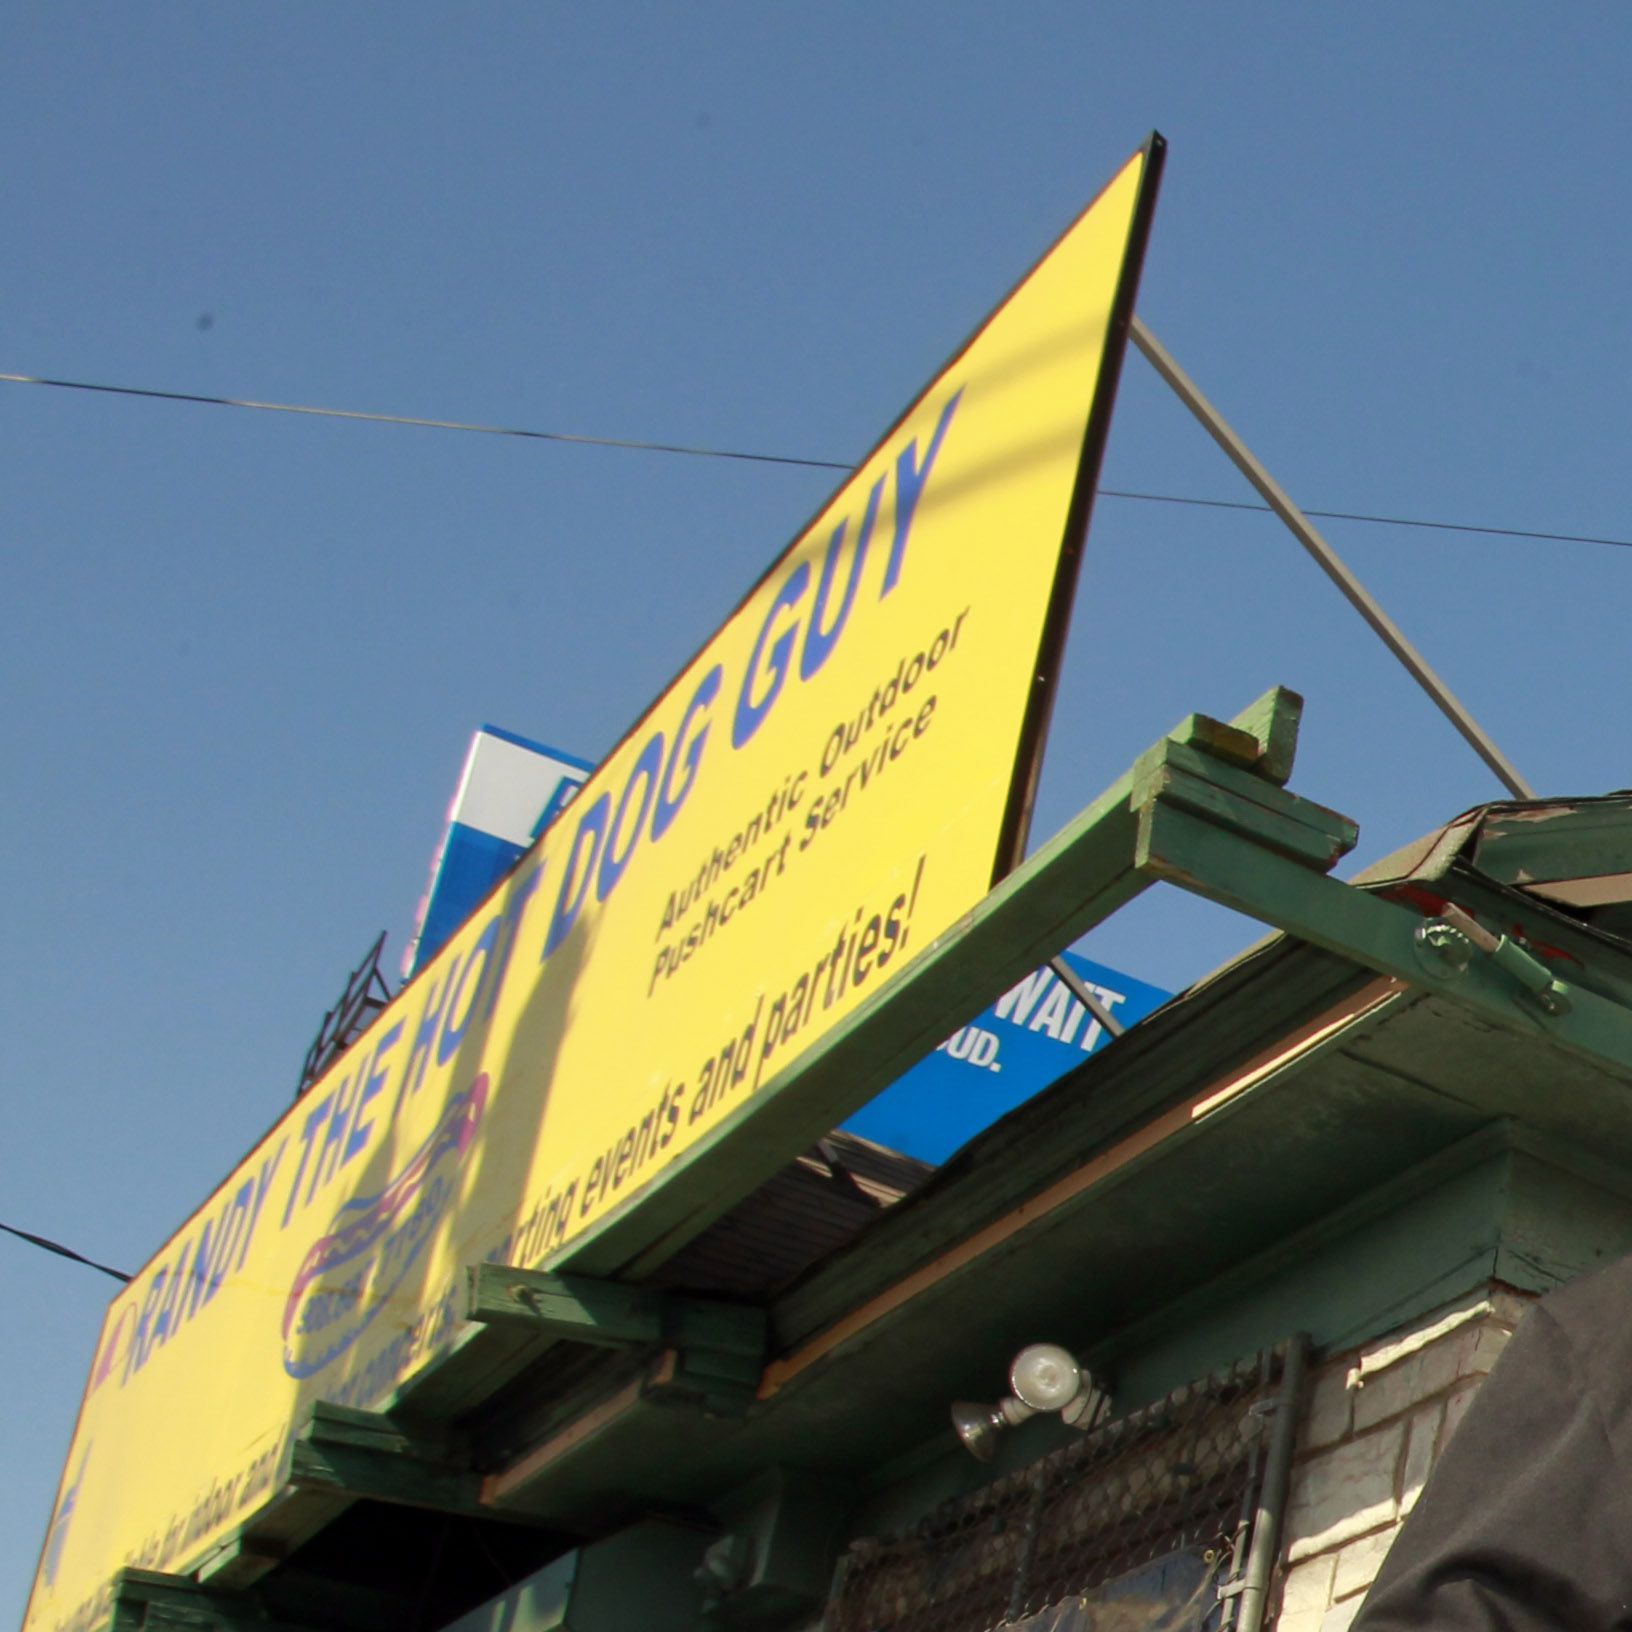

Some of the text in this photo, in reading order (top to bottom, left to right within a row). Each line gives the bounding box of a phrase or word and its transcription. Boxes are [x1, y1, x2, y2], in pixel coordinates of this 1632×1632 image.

[121, 1134, 289, 1388] RANDY
[281, 1020, 408, 1230] THE
[402, 860, 545, 1098] HOT
[543, 662, 725, 964] DOG
[731, 382, 967, 751] GUY
[647, 694, 938, 998] Pushcart Service
[655, 605, 971, 945] Authentic Outdoor
[580, 1080, 686, 1219] events
[688, 993, 765, 1127] and
[752, 854, 926, 1092] parties!
